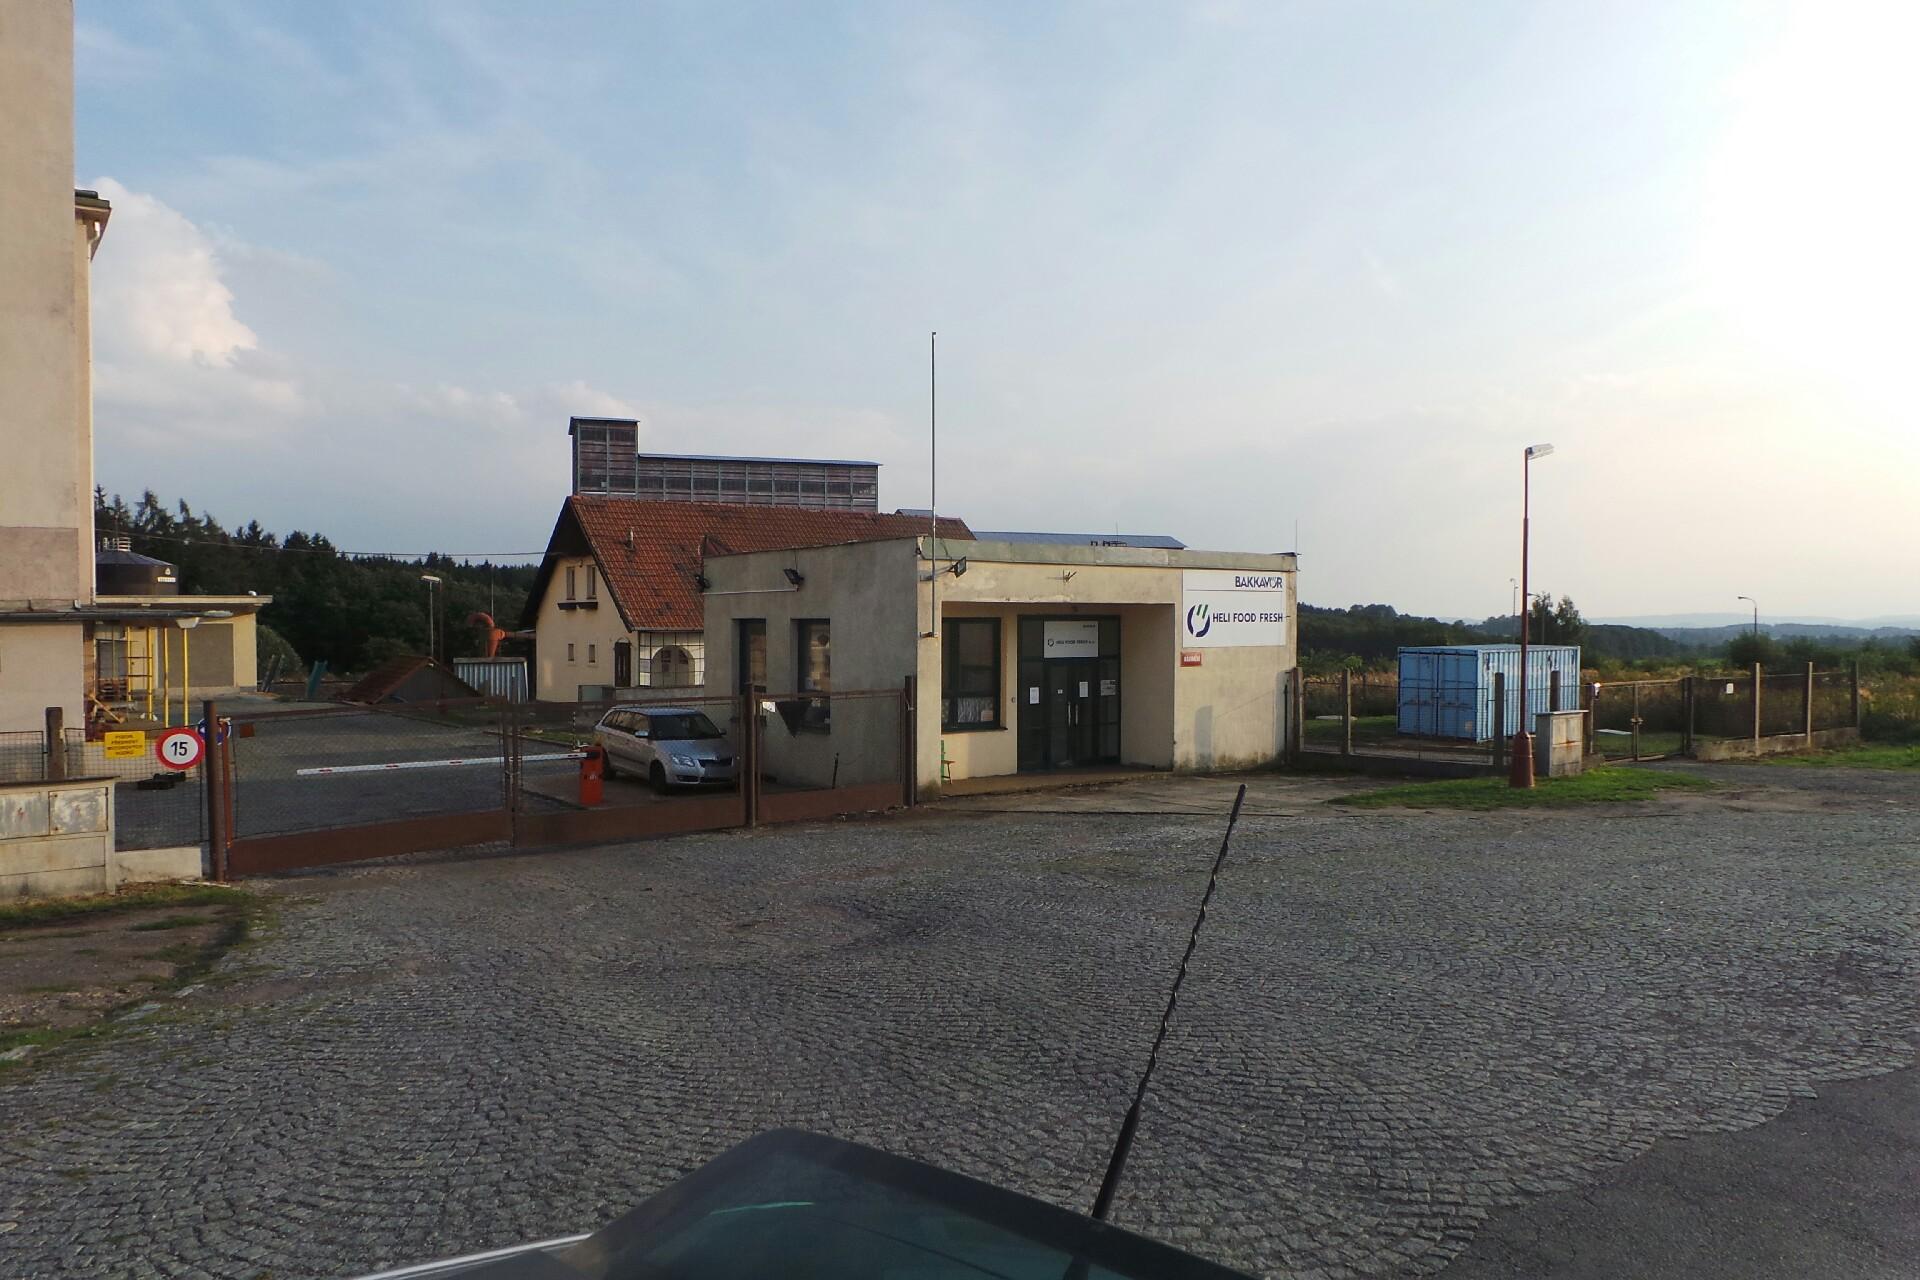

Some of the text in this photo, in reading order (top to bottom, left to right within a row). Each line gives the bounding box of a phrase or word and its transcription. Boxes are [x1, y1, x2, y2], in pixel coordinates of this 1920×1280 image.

[1212, 612, 1283, 623] HELI FOOD FRESH
[170, 741, 188, 757] 15
